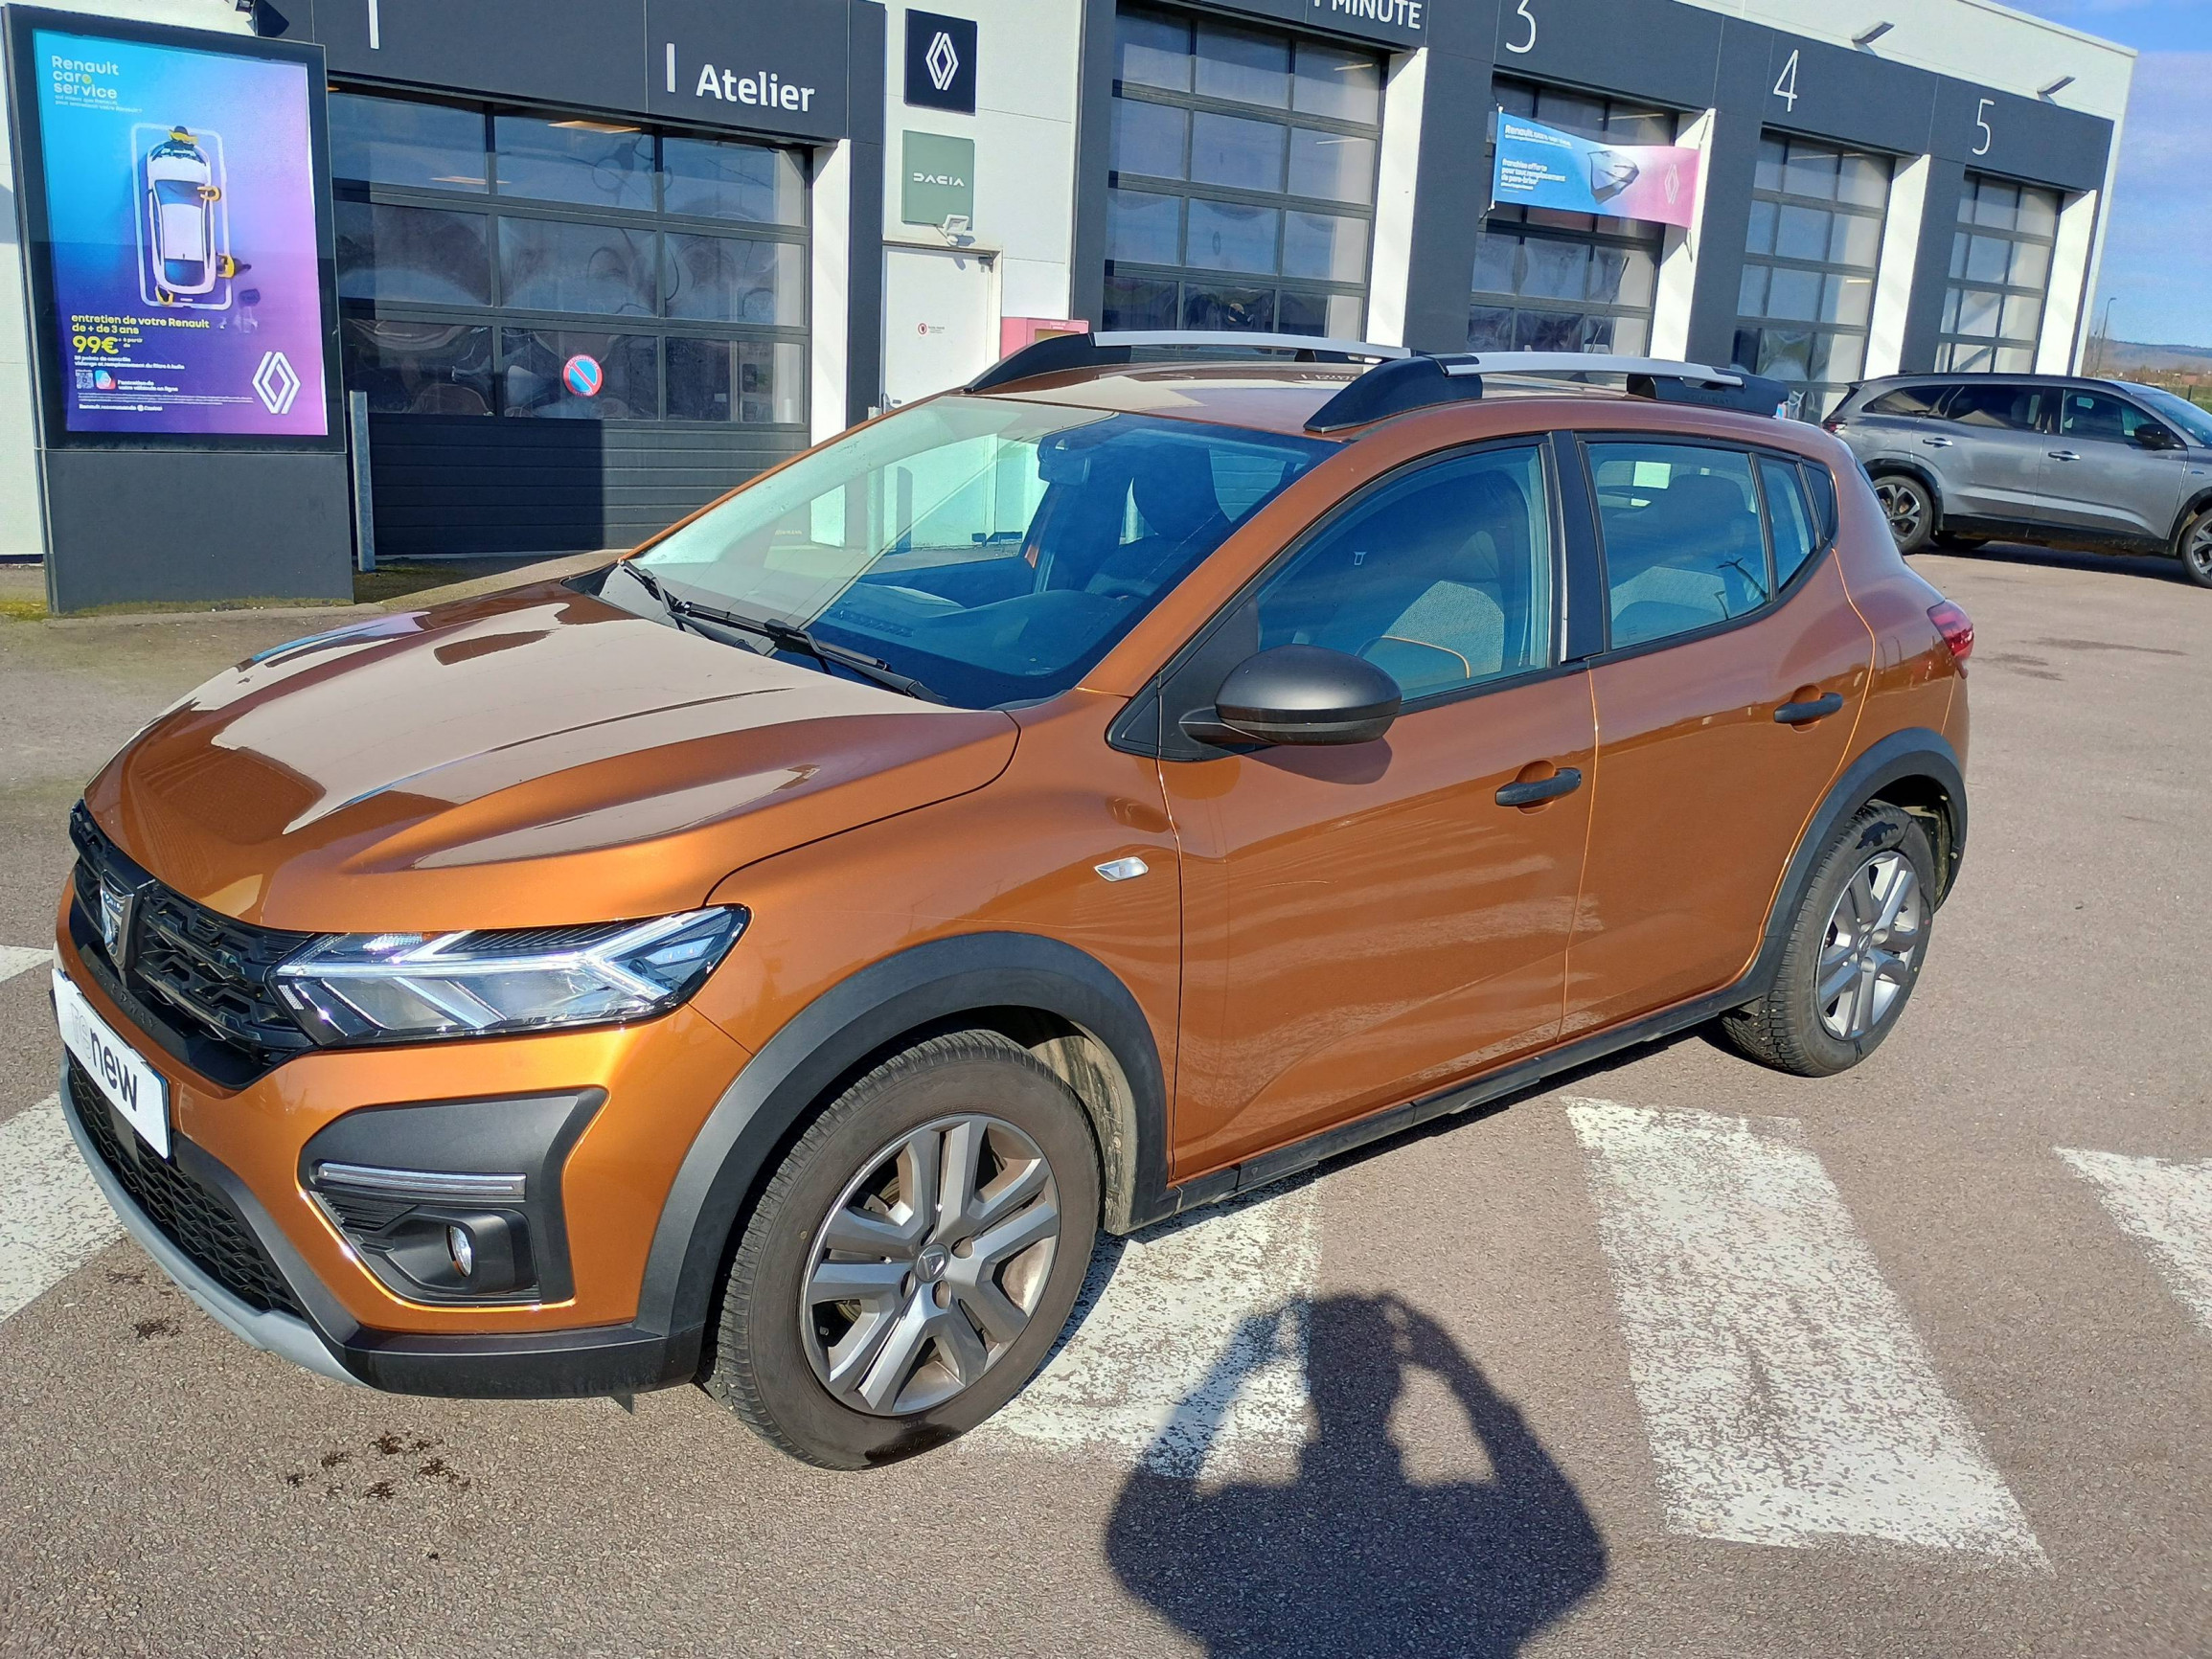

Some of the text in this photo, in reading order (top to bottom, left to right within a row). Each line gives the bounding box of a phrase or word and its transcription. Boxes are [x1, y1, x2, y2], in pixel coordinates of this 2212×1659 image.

[1505, 0, 1537, 54] 3
[51, 55, 119, 76] Renault
[53, 70, 92, 84] care
[696, 63, 815, 112] Atelier
[1772, 49, 1799, 112] 4
[54, 82, 118, 99] service
[1972, 98, 1995, 156] 5
[913, 171, 965, 187] DACIA
[71, 314, 210, 329] entretien de votre Renault
[72, 323, 86, 332] de
[96, 324, 110, 333] de
[111, 325, 118, 333] 3
[69, 1001, 138, 1112] renew
